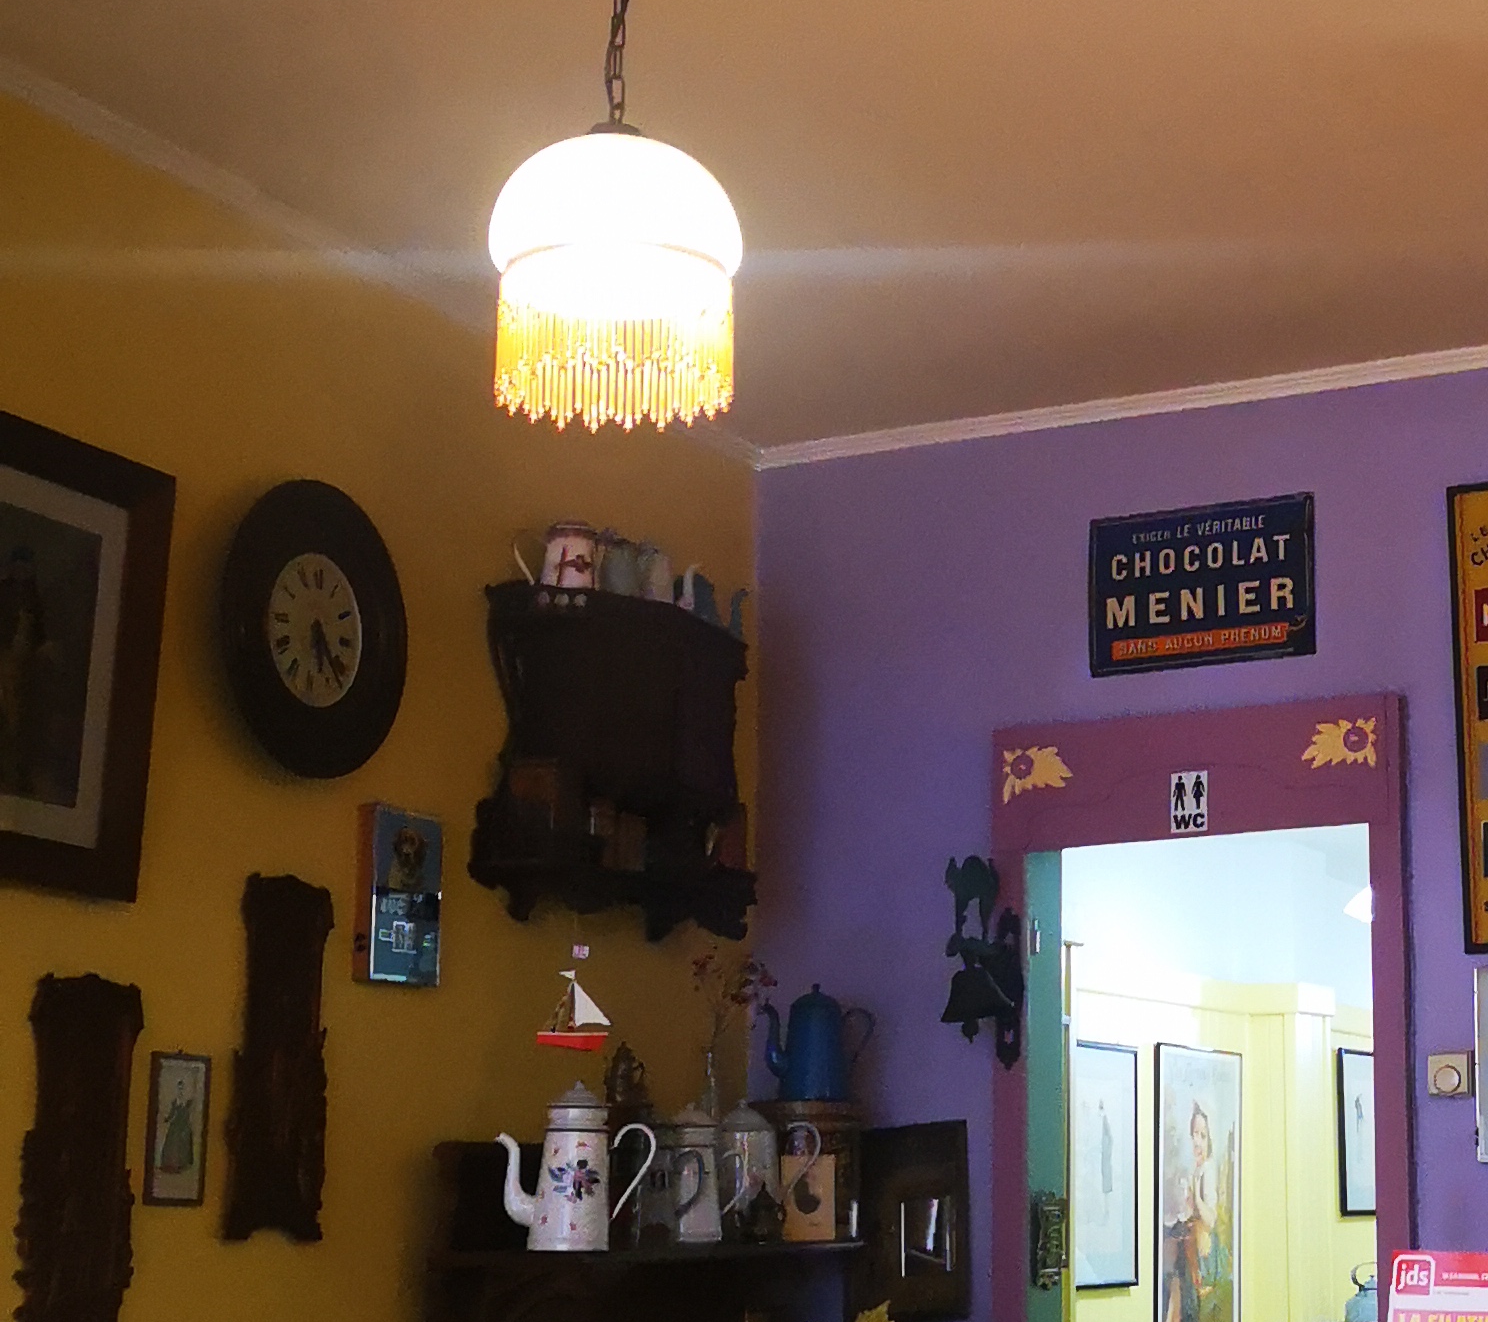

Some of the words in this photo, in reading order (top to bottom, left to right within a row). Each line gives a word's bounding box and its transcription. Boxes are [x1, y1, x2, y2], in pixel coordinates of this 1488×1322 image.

[1176, 524, 1191, 538] LE
[1111, 534, 1291, 580] CHOCOLAT
[1106, 577, 1294, 629] MENIER
[1173, 813, 1205, 830] WC
[1398, 1263, 1428, 1290] jds
